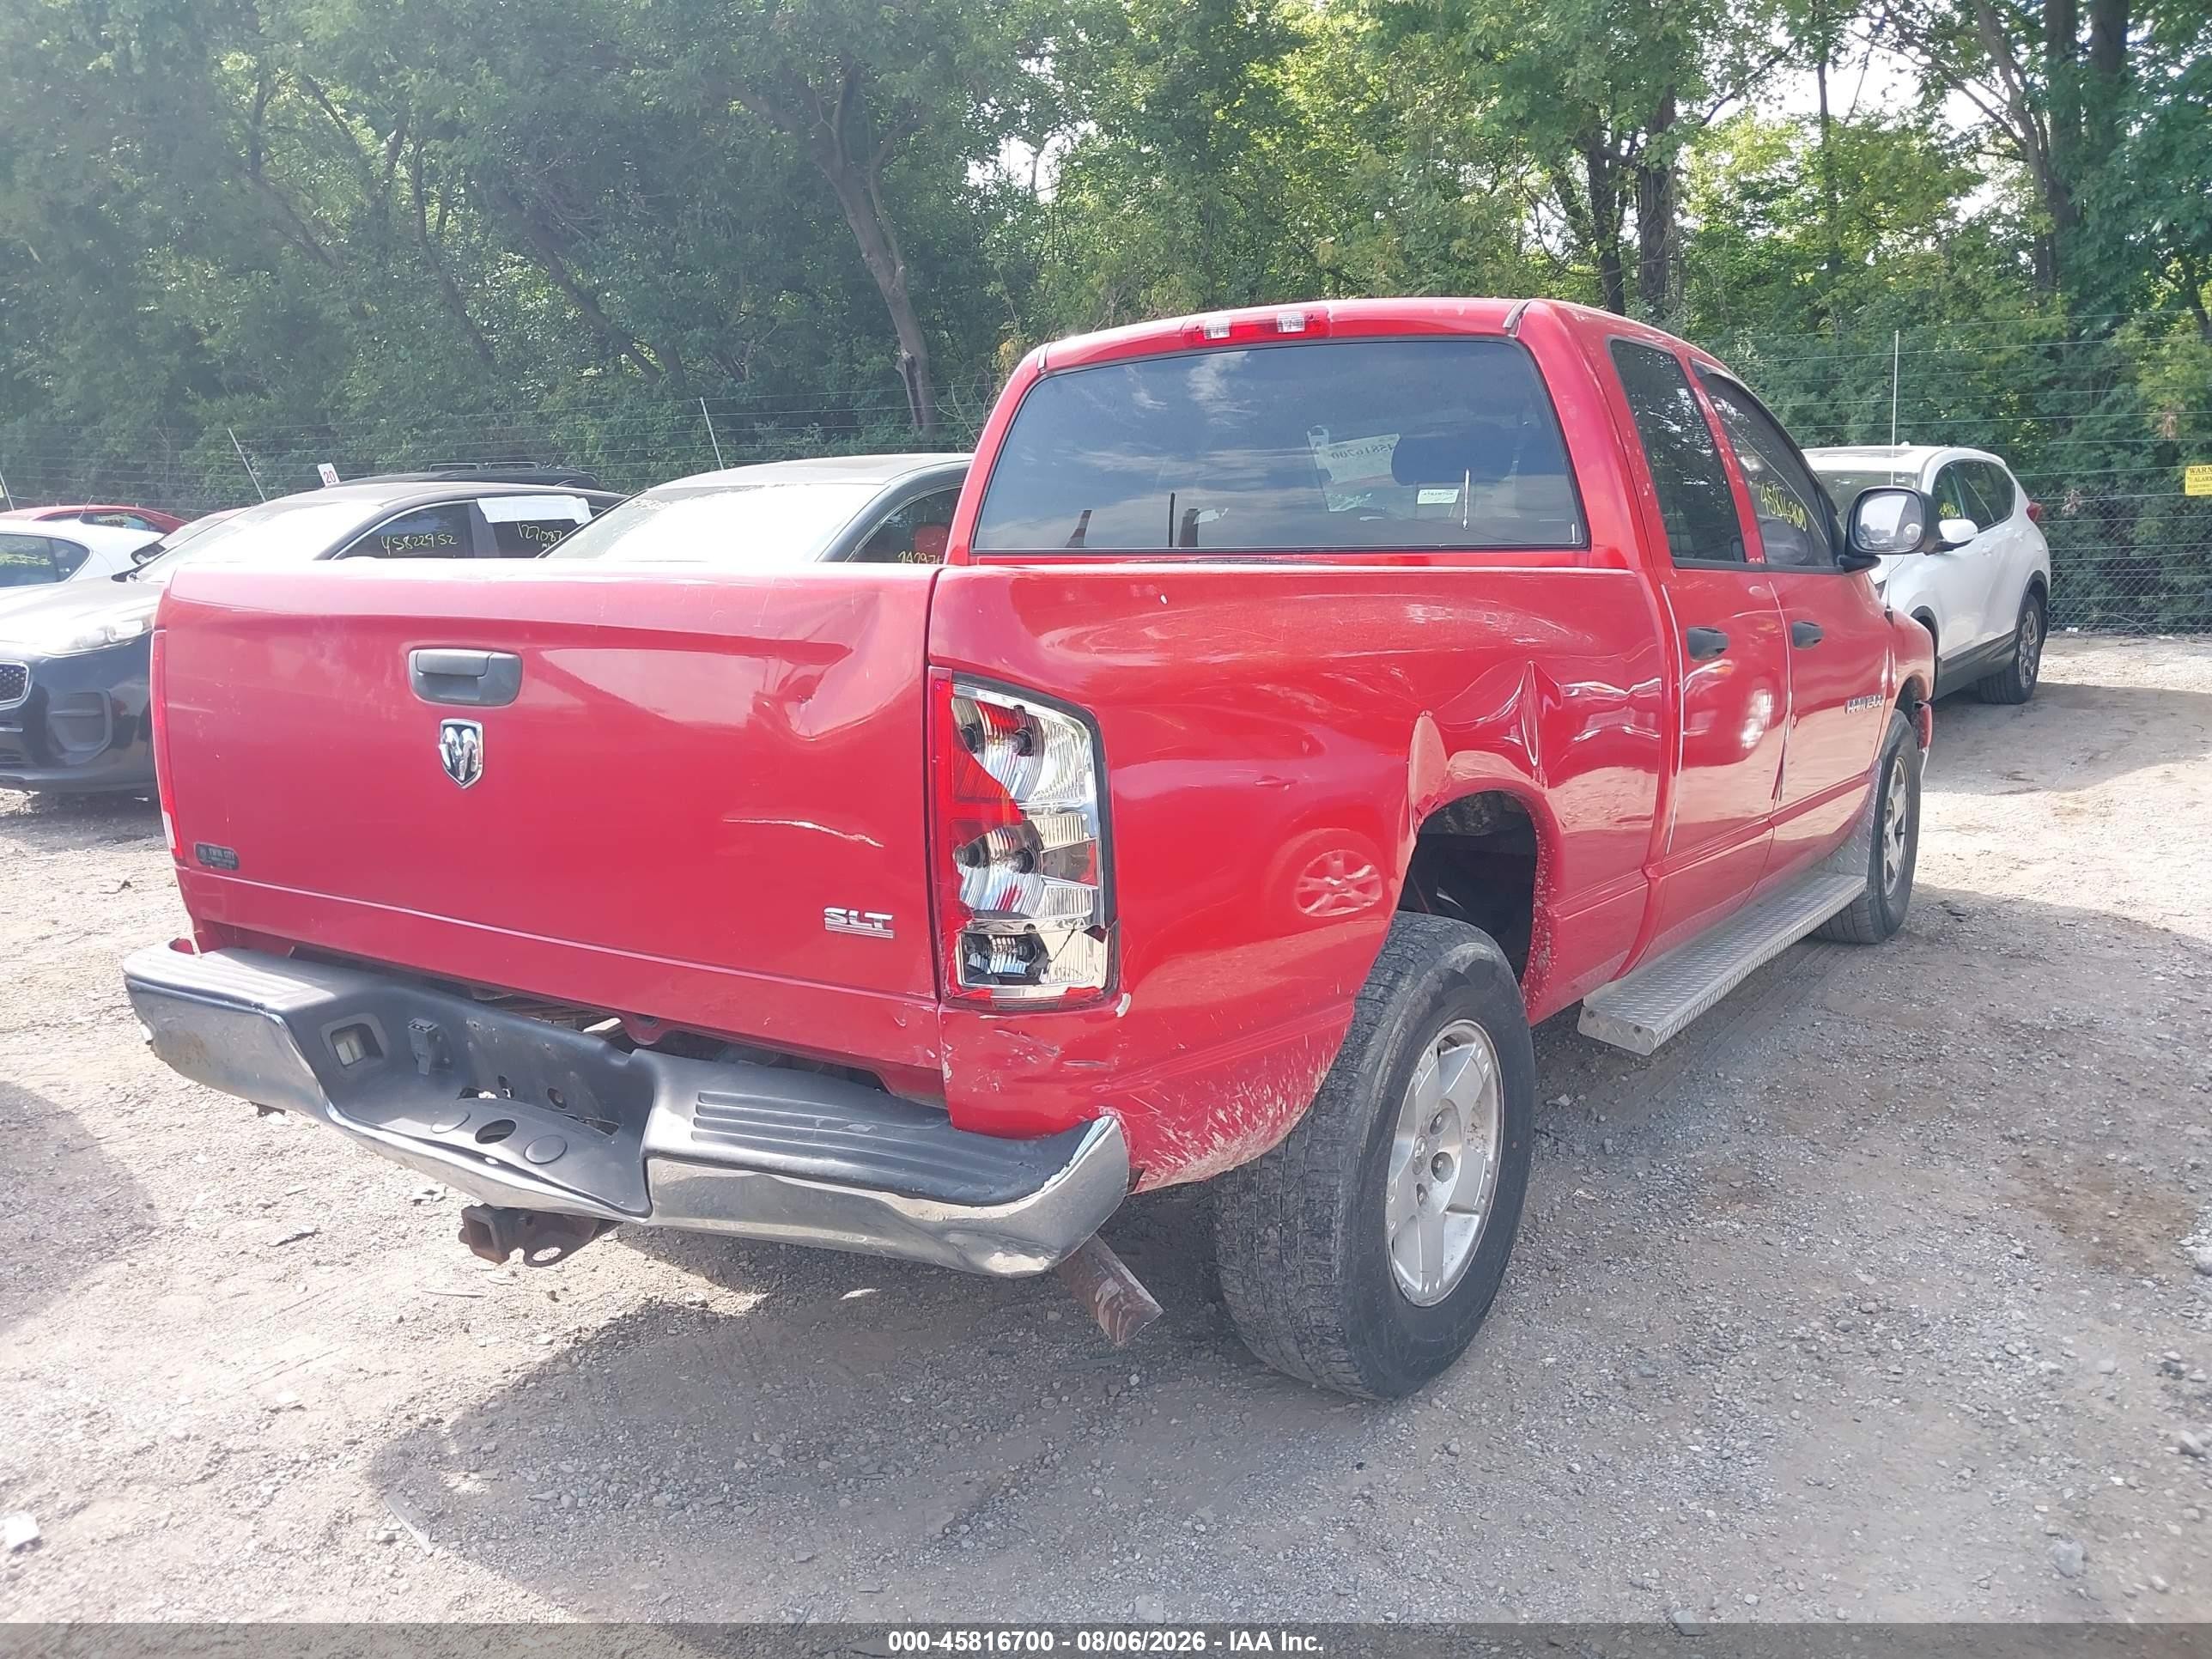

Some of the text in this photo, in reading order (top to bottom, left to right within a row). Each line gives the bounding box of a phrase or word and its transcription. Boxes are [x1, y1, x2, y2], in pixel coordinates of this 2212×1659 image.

[323, 470, 336, 483] 20
[516, 522, 562, 542] 127087
[823, 907, 894, 930] SLT
